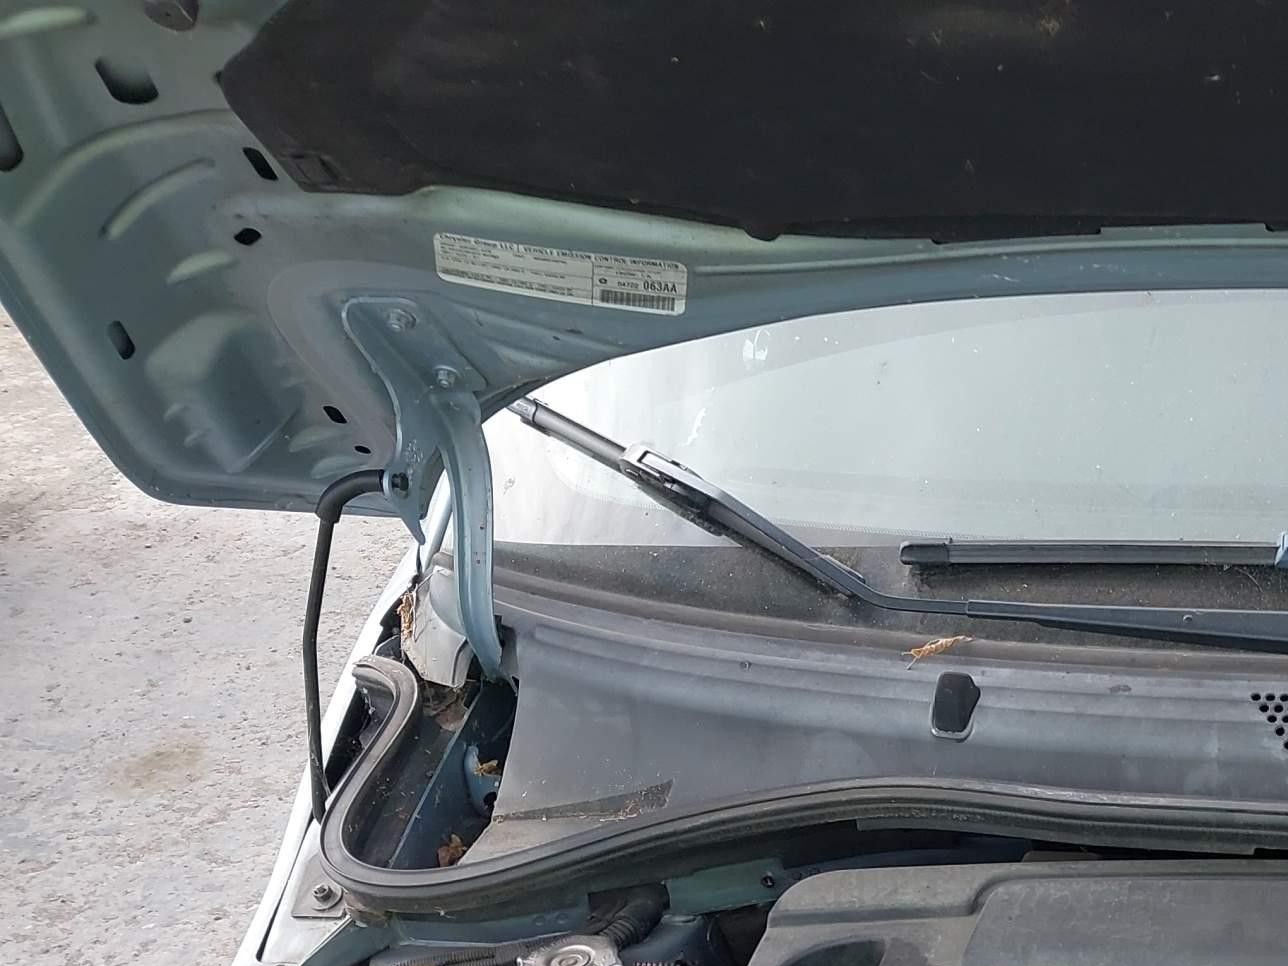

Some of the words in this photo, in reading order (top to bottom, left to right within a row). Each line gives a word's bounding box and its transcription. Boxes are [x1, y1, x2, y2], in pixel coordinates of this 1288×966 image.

[594, 254, 626, 265] CONTROL
[629, 258, 680, 270] INFORMATION
[643, 280, 677, 294] 063AA
